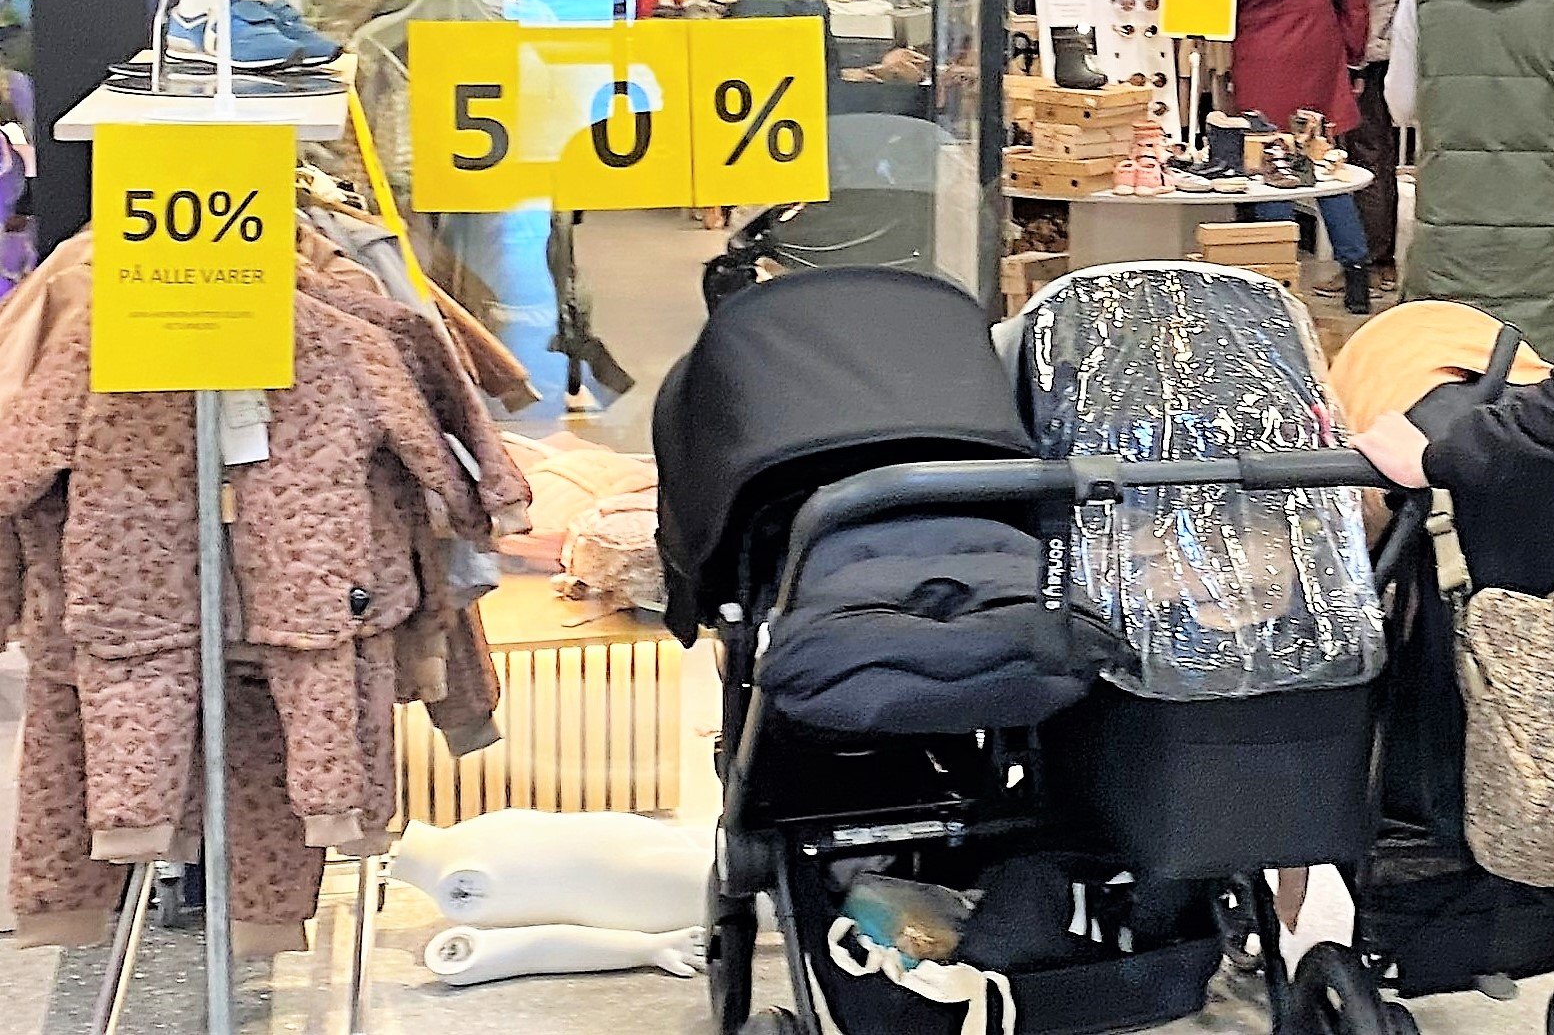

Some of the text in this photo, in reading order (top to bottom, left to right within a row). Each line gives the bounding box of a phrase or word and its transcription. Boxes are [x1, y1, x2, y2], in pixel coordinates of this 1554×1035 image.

[451, 75, 805, 171] 50%
[122, 190, 264, 243] 50%
[119, 264, 265, 284] PÅ ALLE VARER
